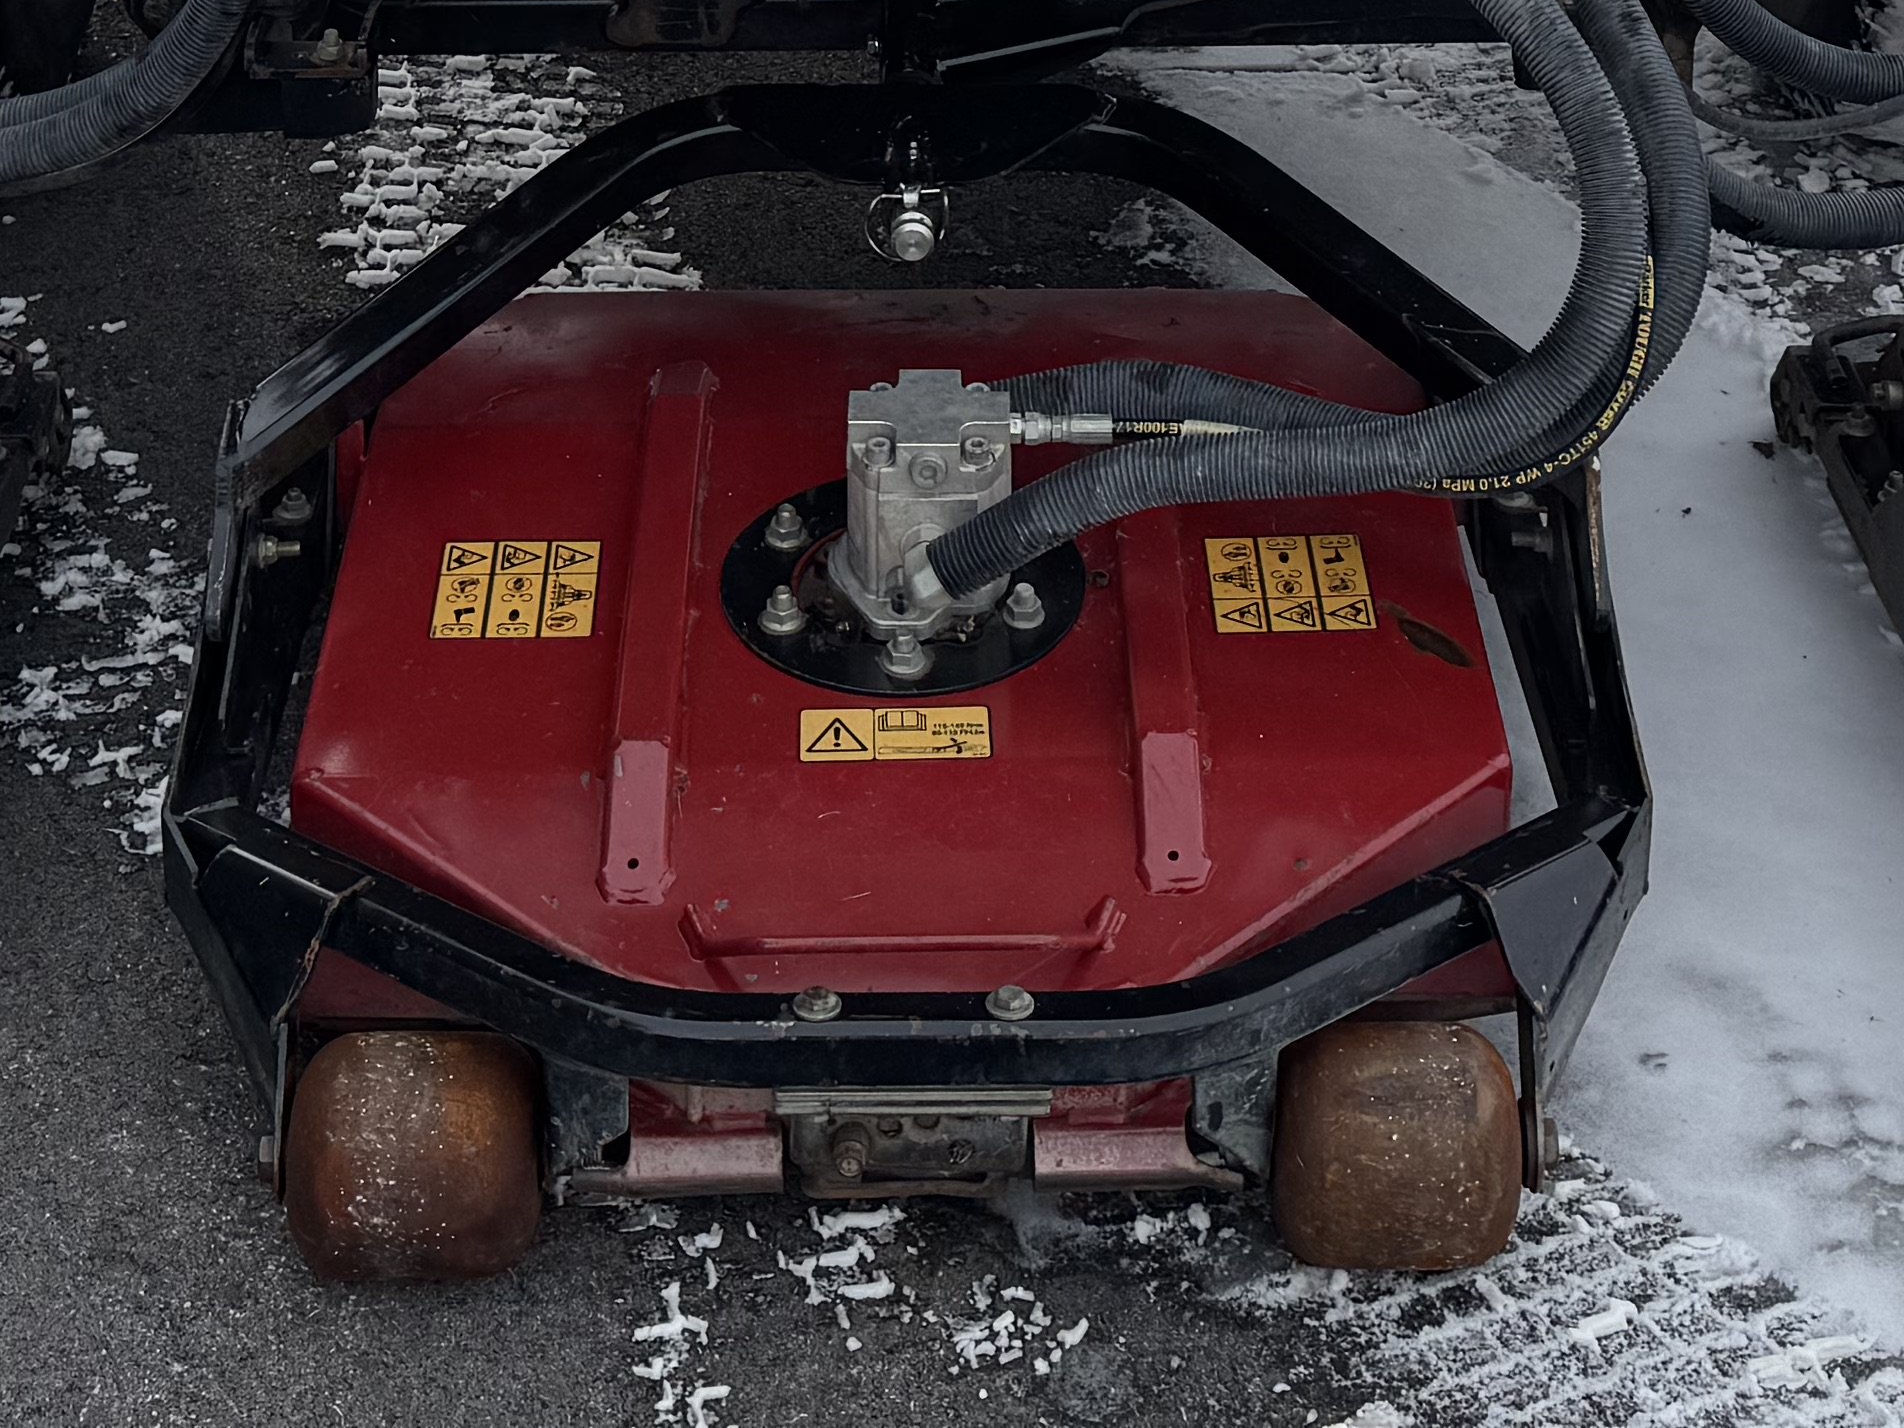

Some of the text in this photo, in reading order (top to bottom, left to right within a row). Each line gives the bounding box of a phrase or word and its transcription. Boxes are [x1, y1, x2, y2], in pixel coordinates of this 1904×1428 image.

[1626, 311, 1653, 379] TOUGH
[1596, 379, 1635, 431] COVER
[1442, 477, 1475, 492] MPa
[1479, 475, 1512, 491] 21.0
[1516, 470, 1542, 485] WP
